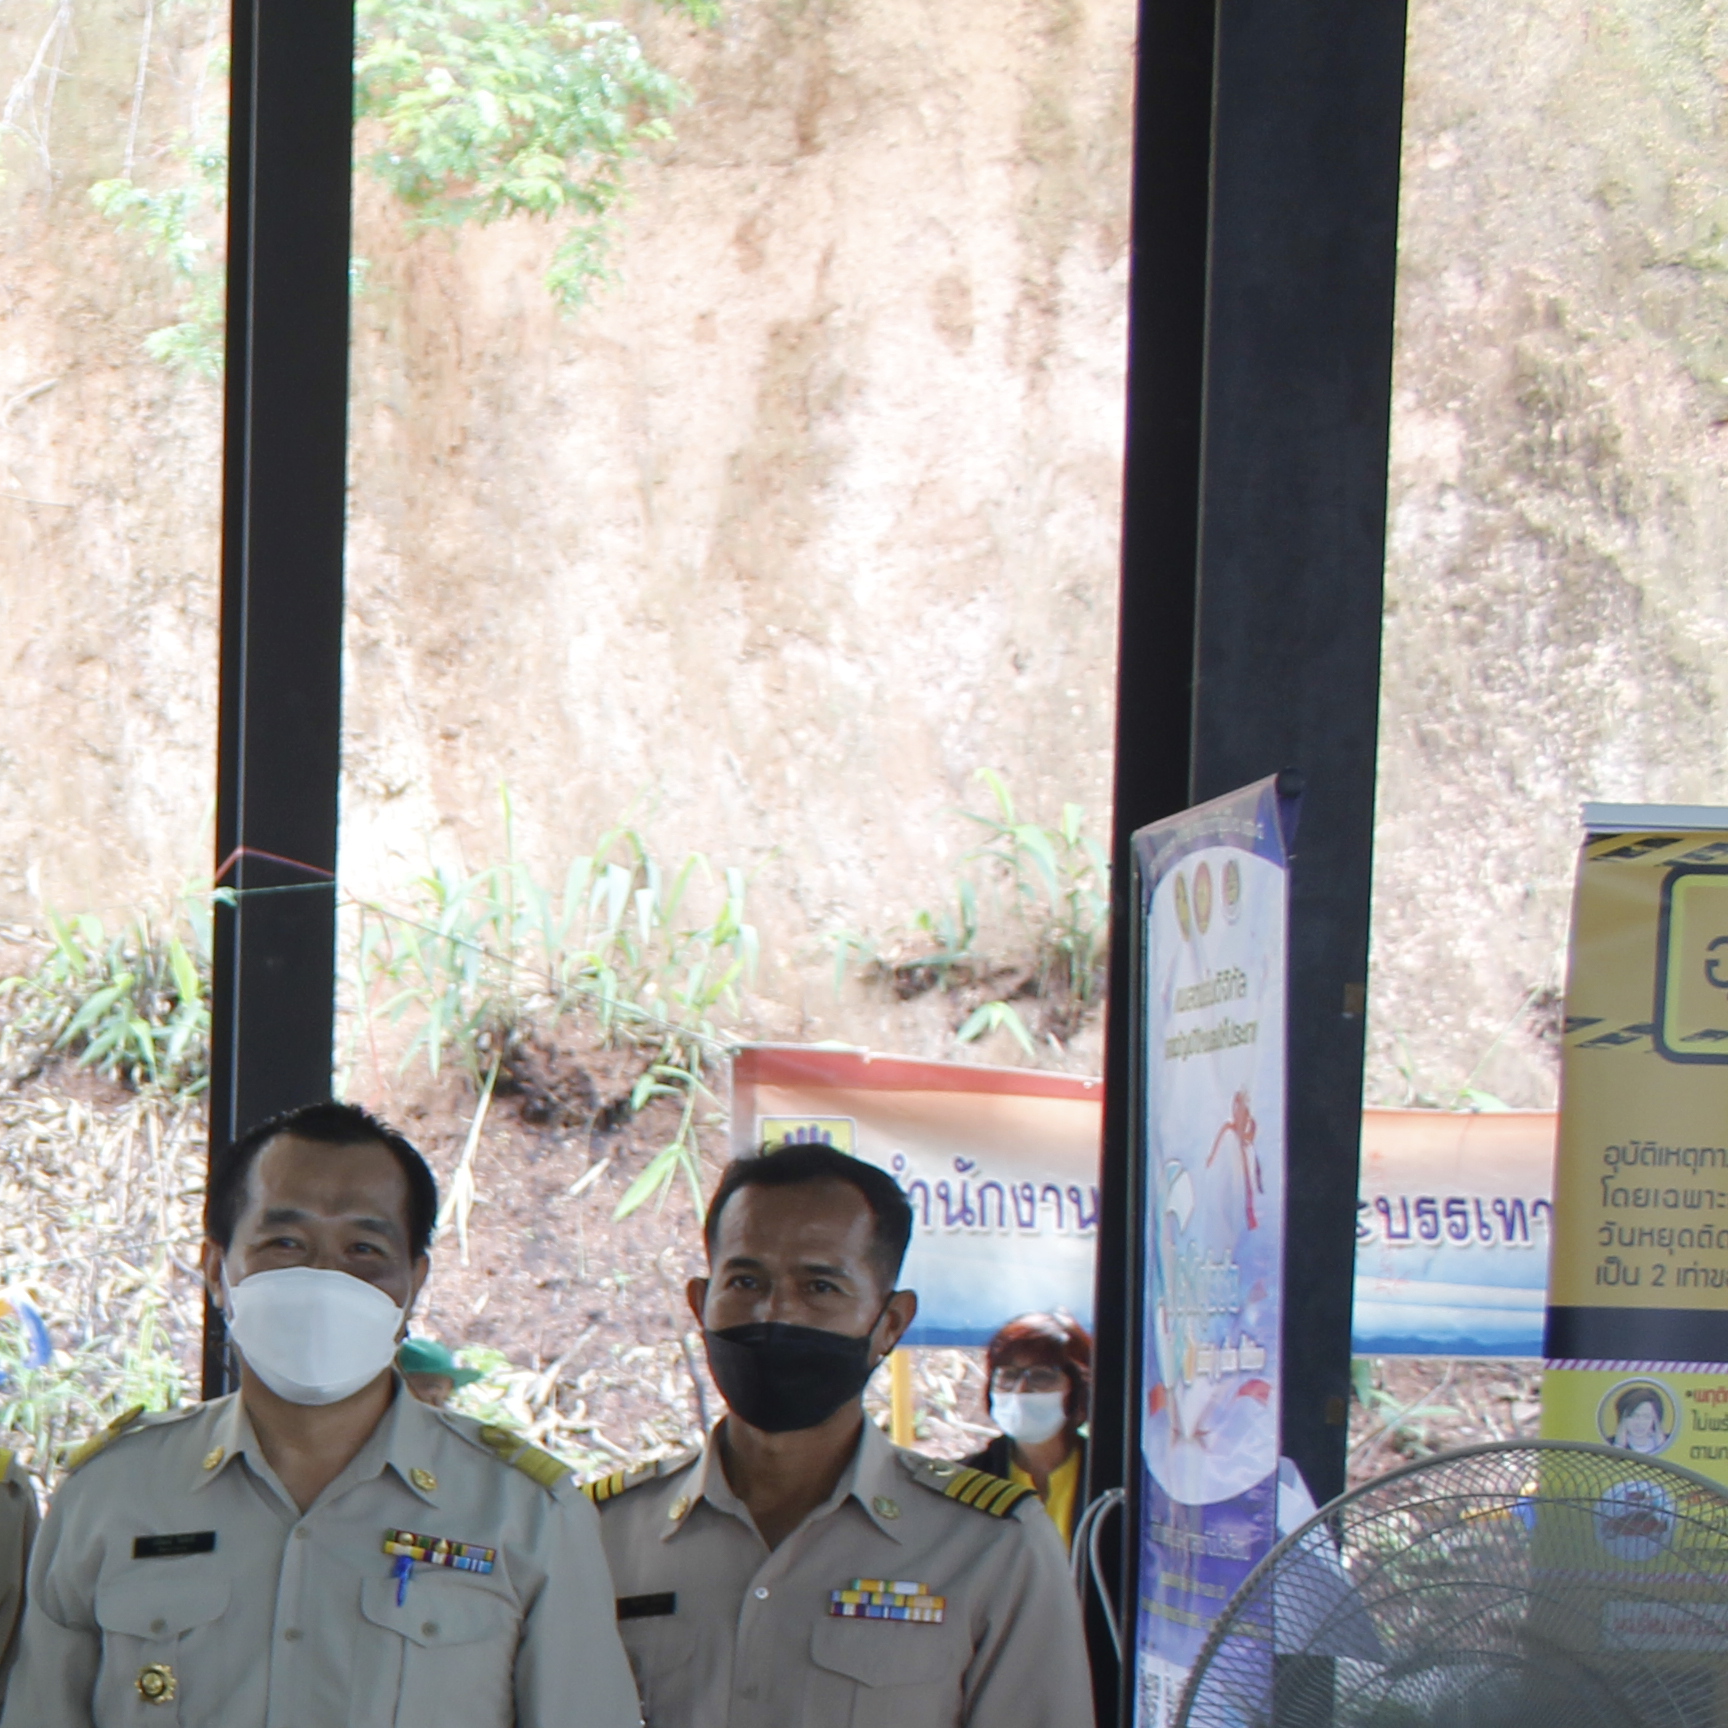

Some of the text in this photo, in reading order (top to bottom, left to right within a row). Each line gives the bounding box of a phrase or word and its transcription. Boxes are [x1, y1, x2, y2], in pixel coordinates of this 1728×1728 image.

[1603, 1140, 1728, 1175] อุบัติเหตุทา
[1595, 1256, 1641, 1287] เป็น
[1651, 1264, 1666, 1287] 2
